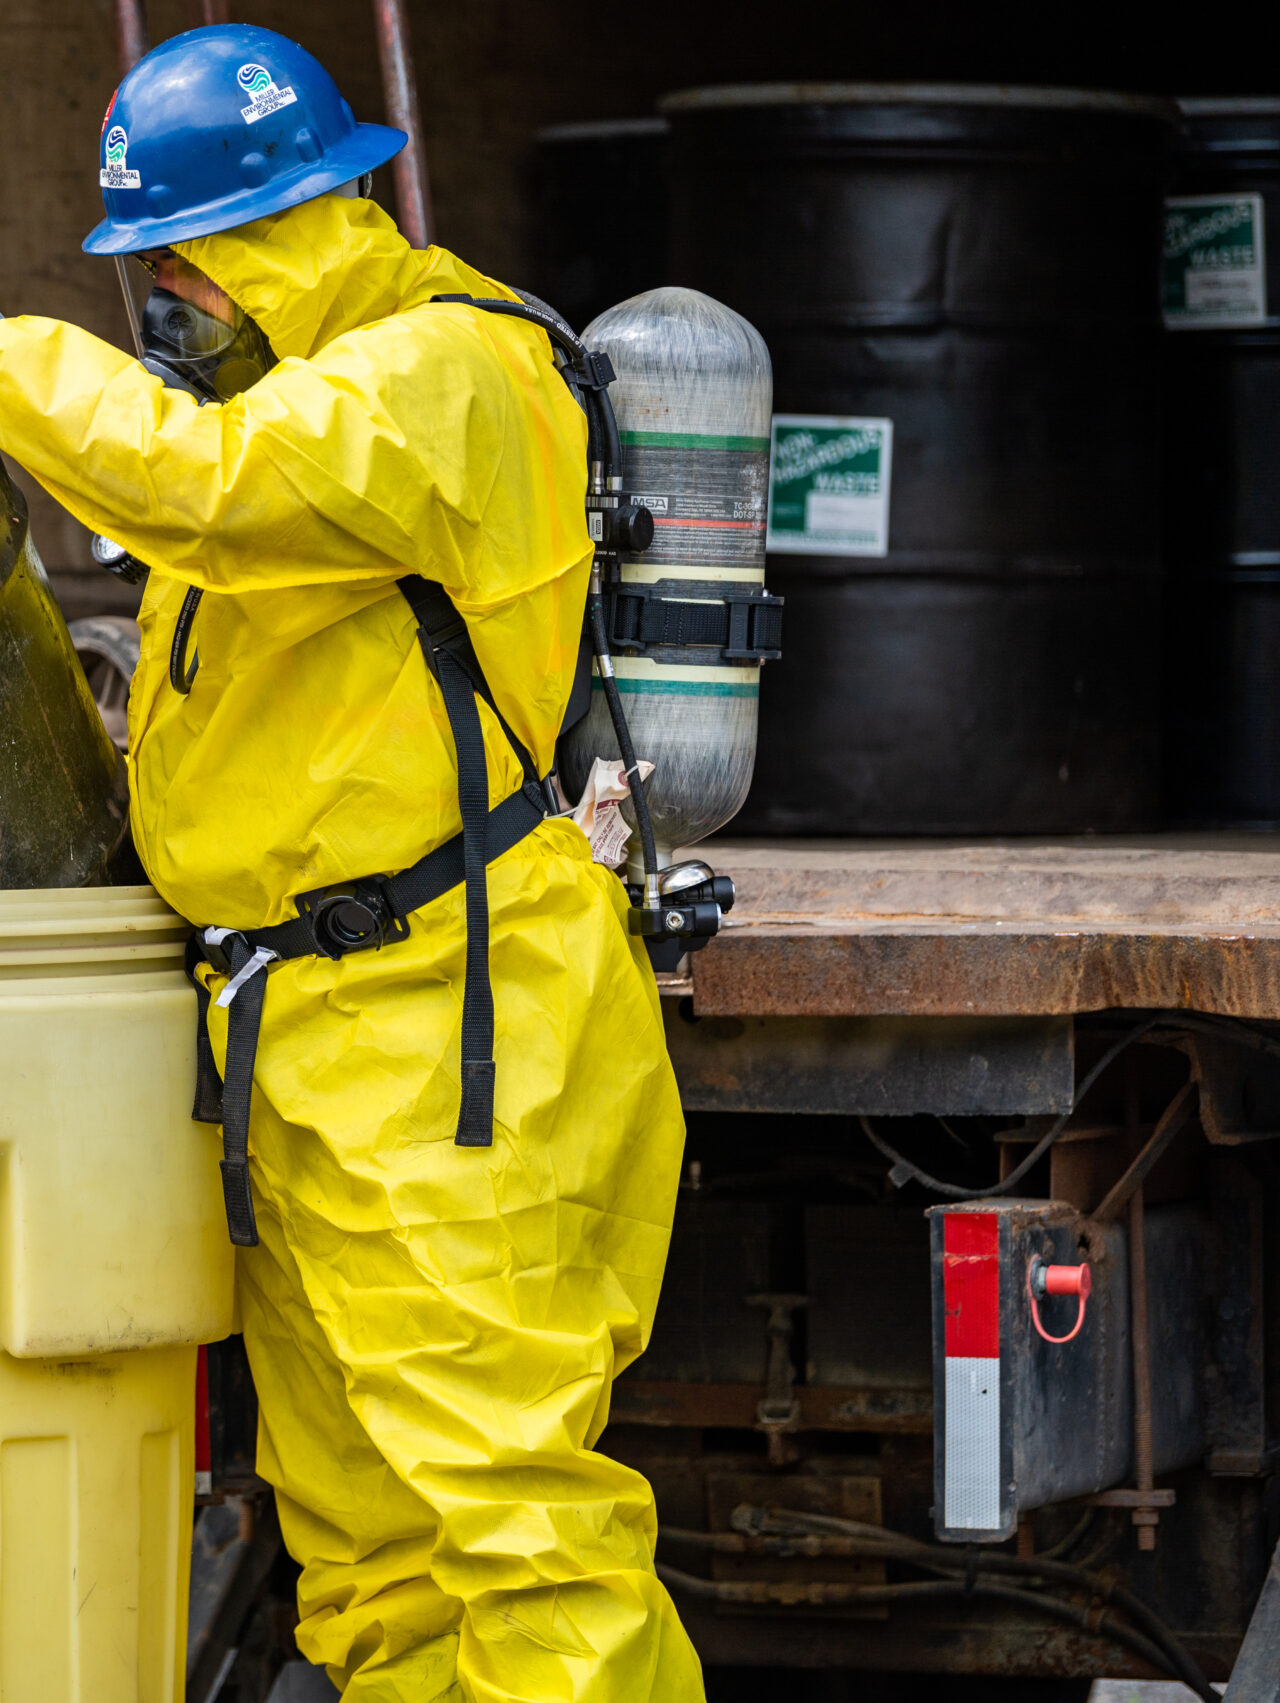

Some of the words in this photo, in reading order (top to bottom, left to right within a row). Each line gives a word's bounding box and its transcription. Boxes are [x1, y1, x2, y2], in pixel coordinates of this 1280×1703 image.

[255, 89, 275, 102] MILLER
[243, 89, 292, 116] ENVIRONMENTAL
[101, 171, 138, 180] ENVIRONMENTAL
[556, 322, 576, 341] TESTED
[633, 497, 666, 508] MSA
